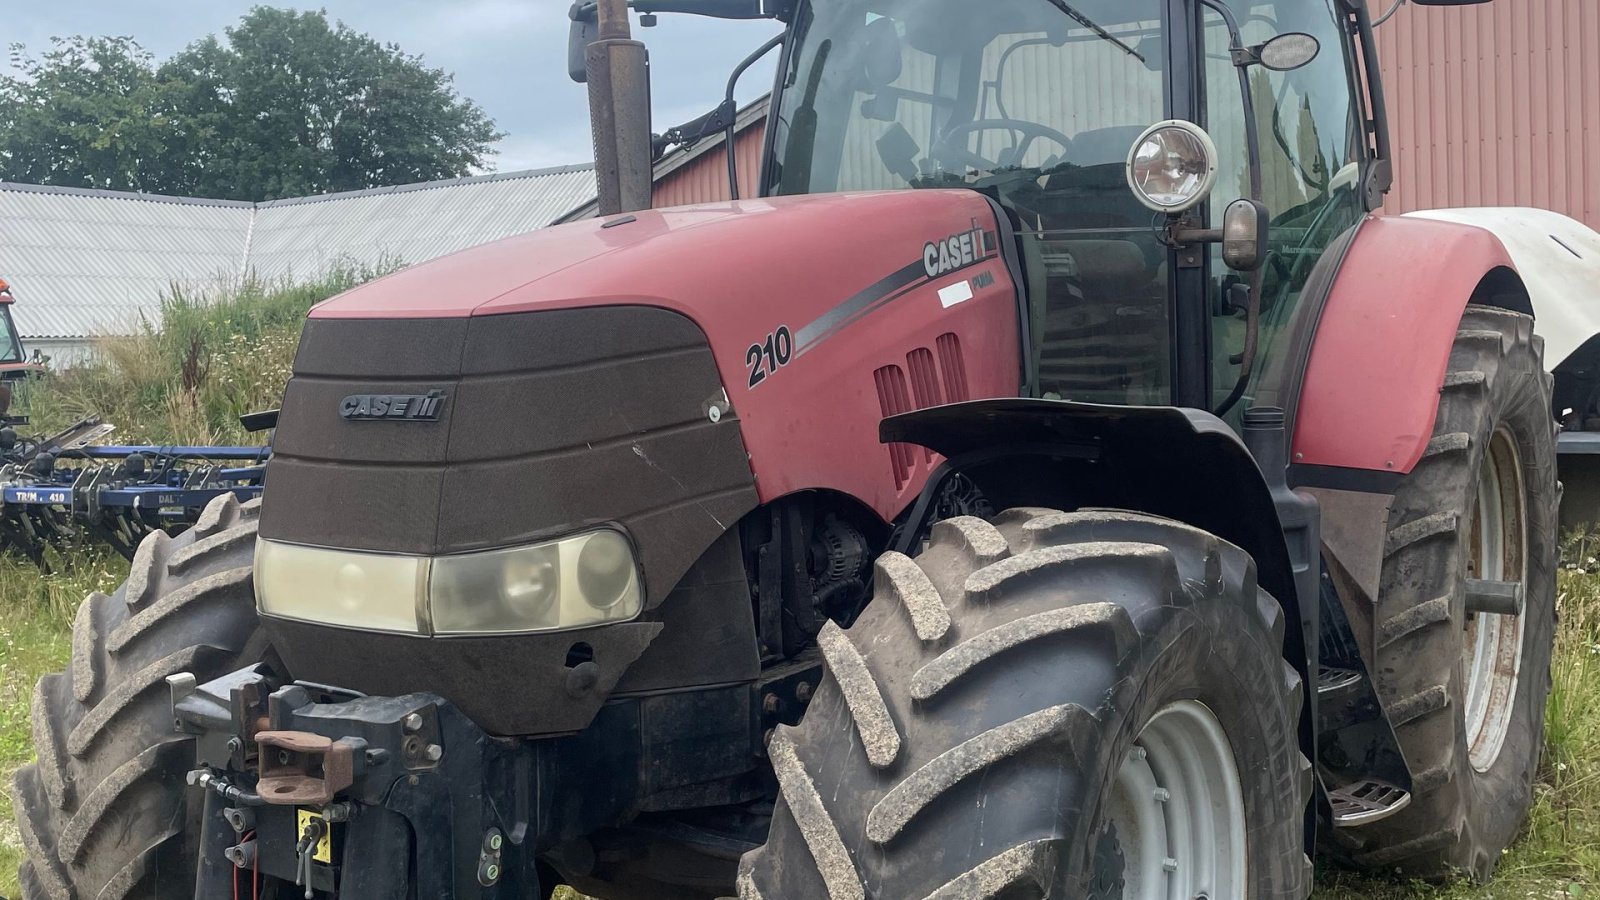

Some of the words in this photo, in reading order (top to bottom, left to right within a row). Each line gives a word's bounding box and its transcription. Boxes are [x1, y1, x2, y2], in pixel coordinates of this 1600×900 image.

[923, 233, 973, 277] CASE
[972, 270, 995, 290] PUMA
[745, 324, 792, 391] 210
[339, 395, 409, 417] CASE
